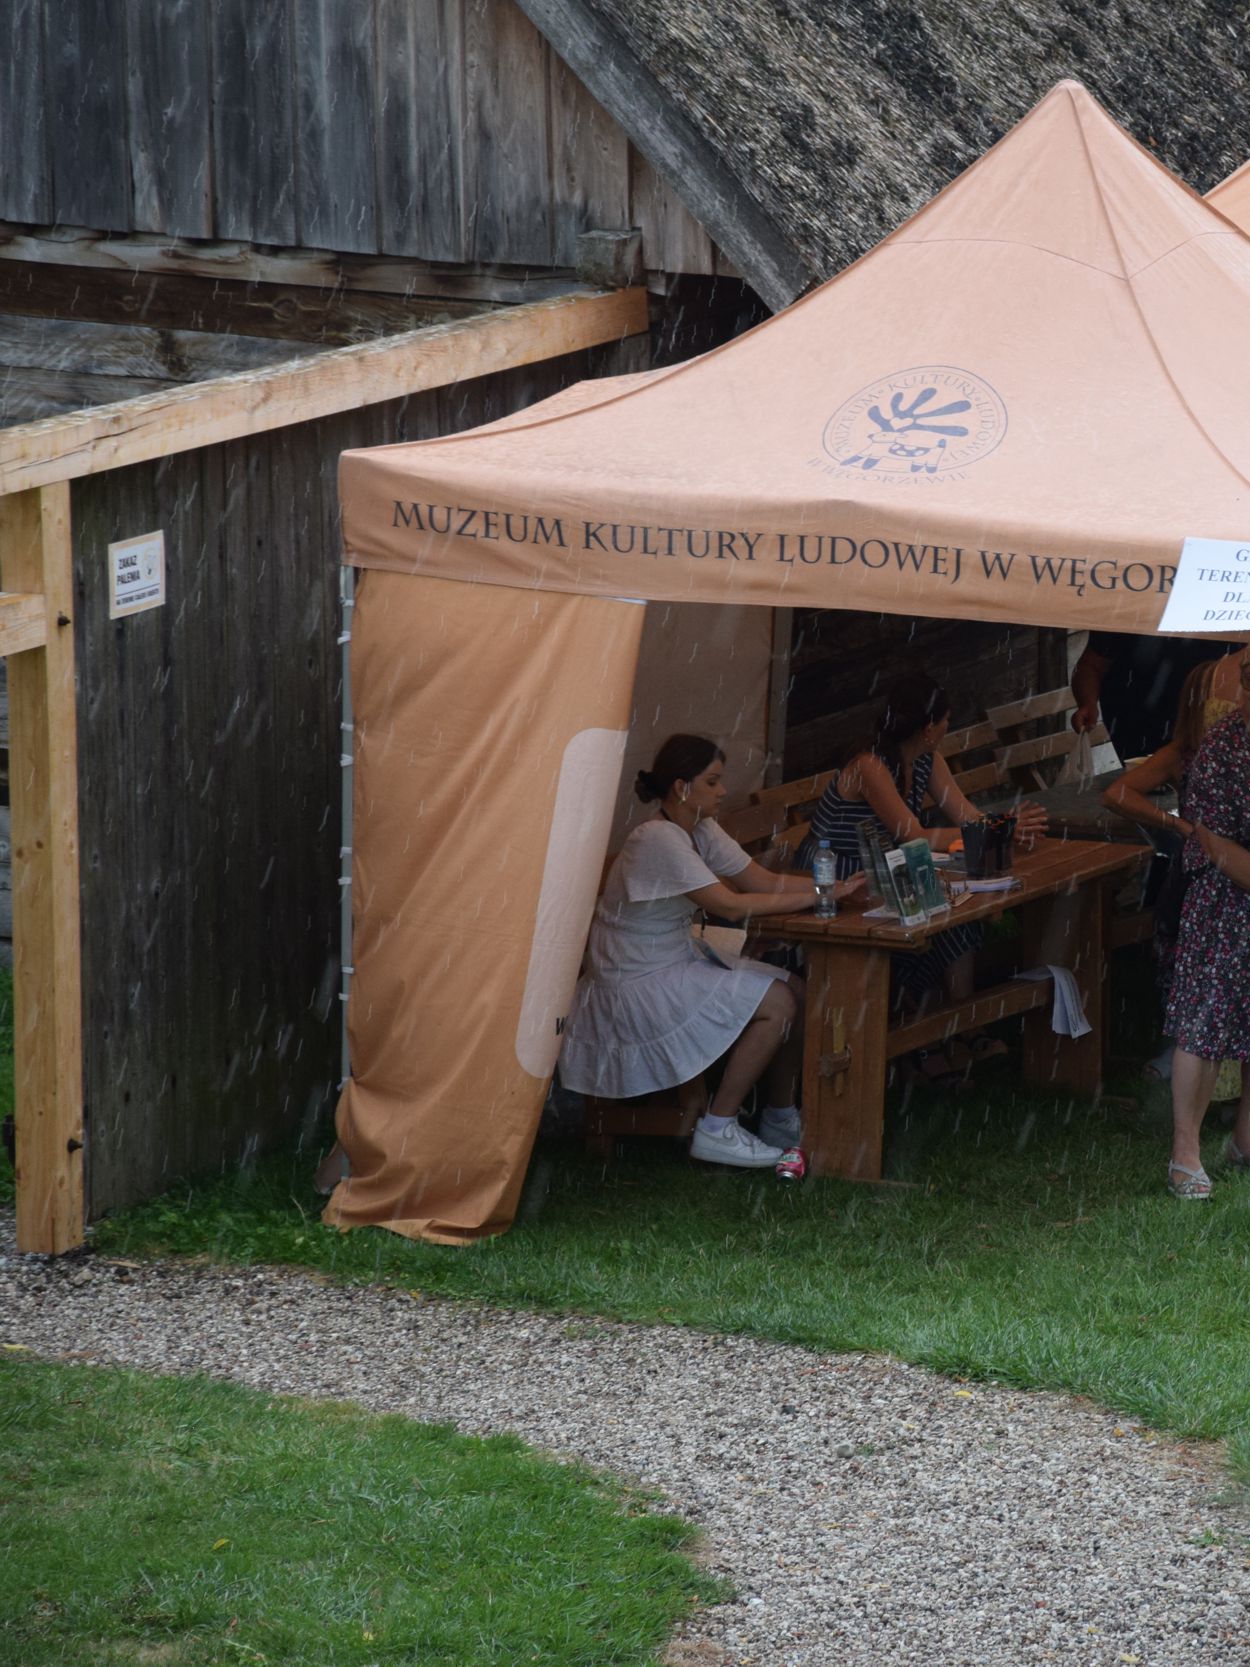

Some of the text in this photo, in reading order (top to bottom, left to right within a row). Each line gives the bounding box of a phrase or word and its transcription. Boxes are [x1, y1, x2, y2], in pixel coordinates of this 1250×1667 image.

[888, 373, 981, 398] KULTURY
[391, 500, 568, 547] MUZEUM
[582, 520, 764, 561] KULTURY
[776, 534, 965, 584] LUDOWEJ
[978, 550, 1017, 580] W
